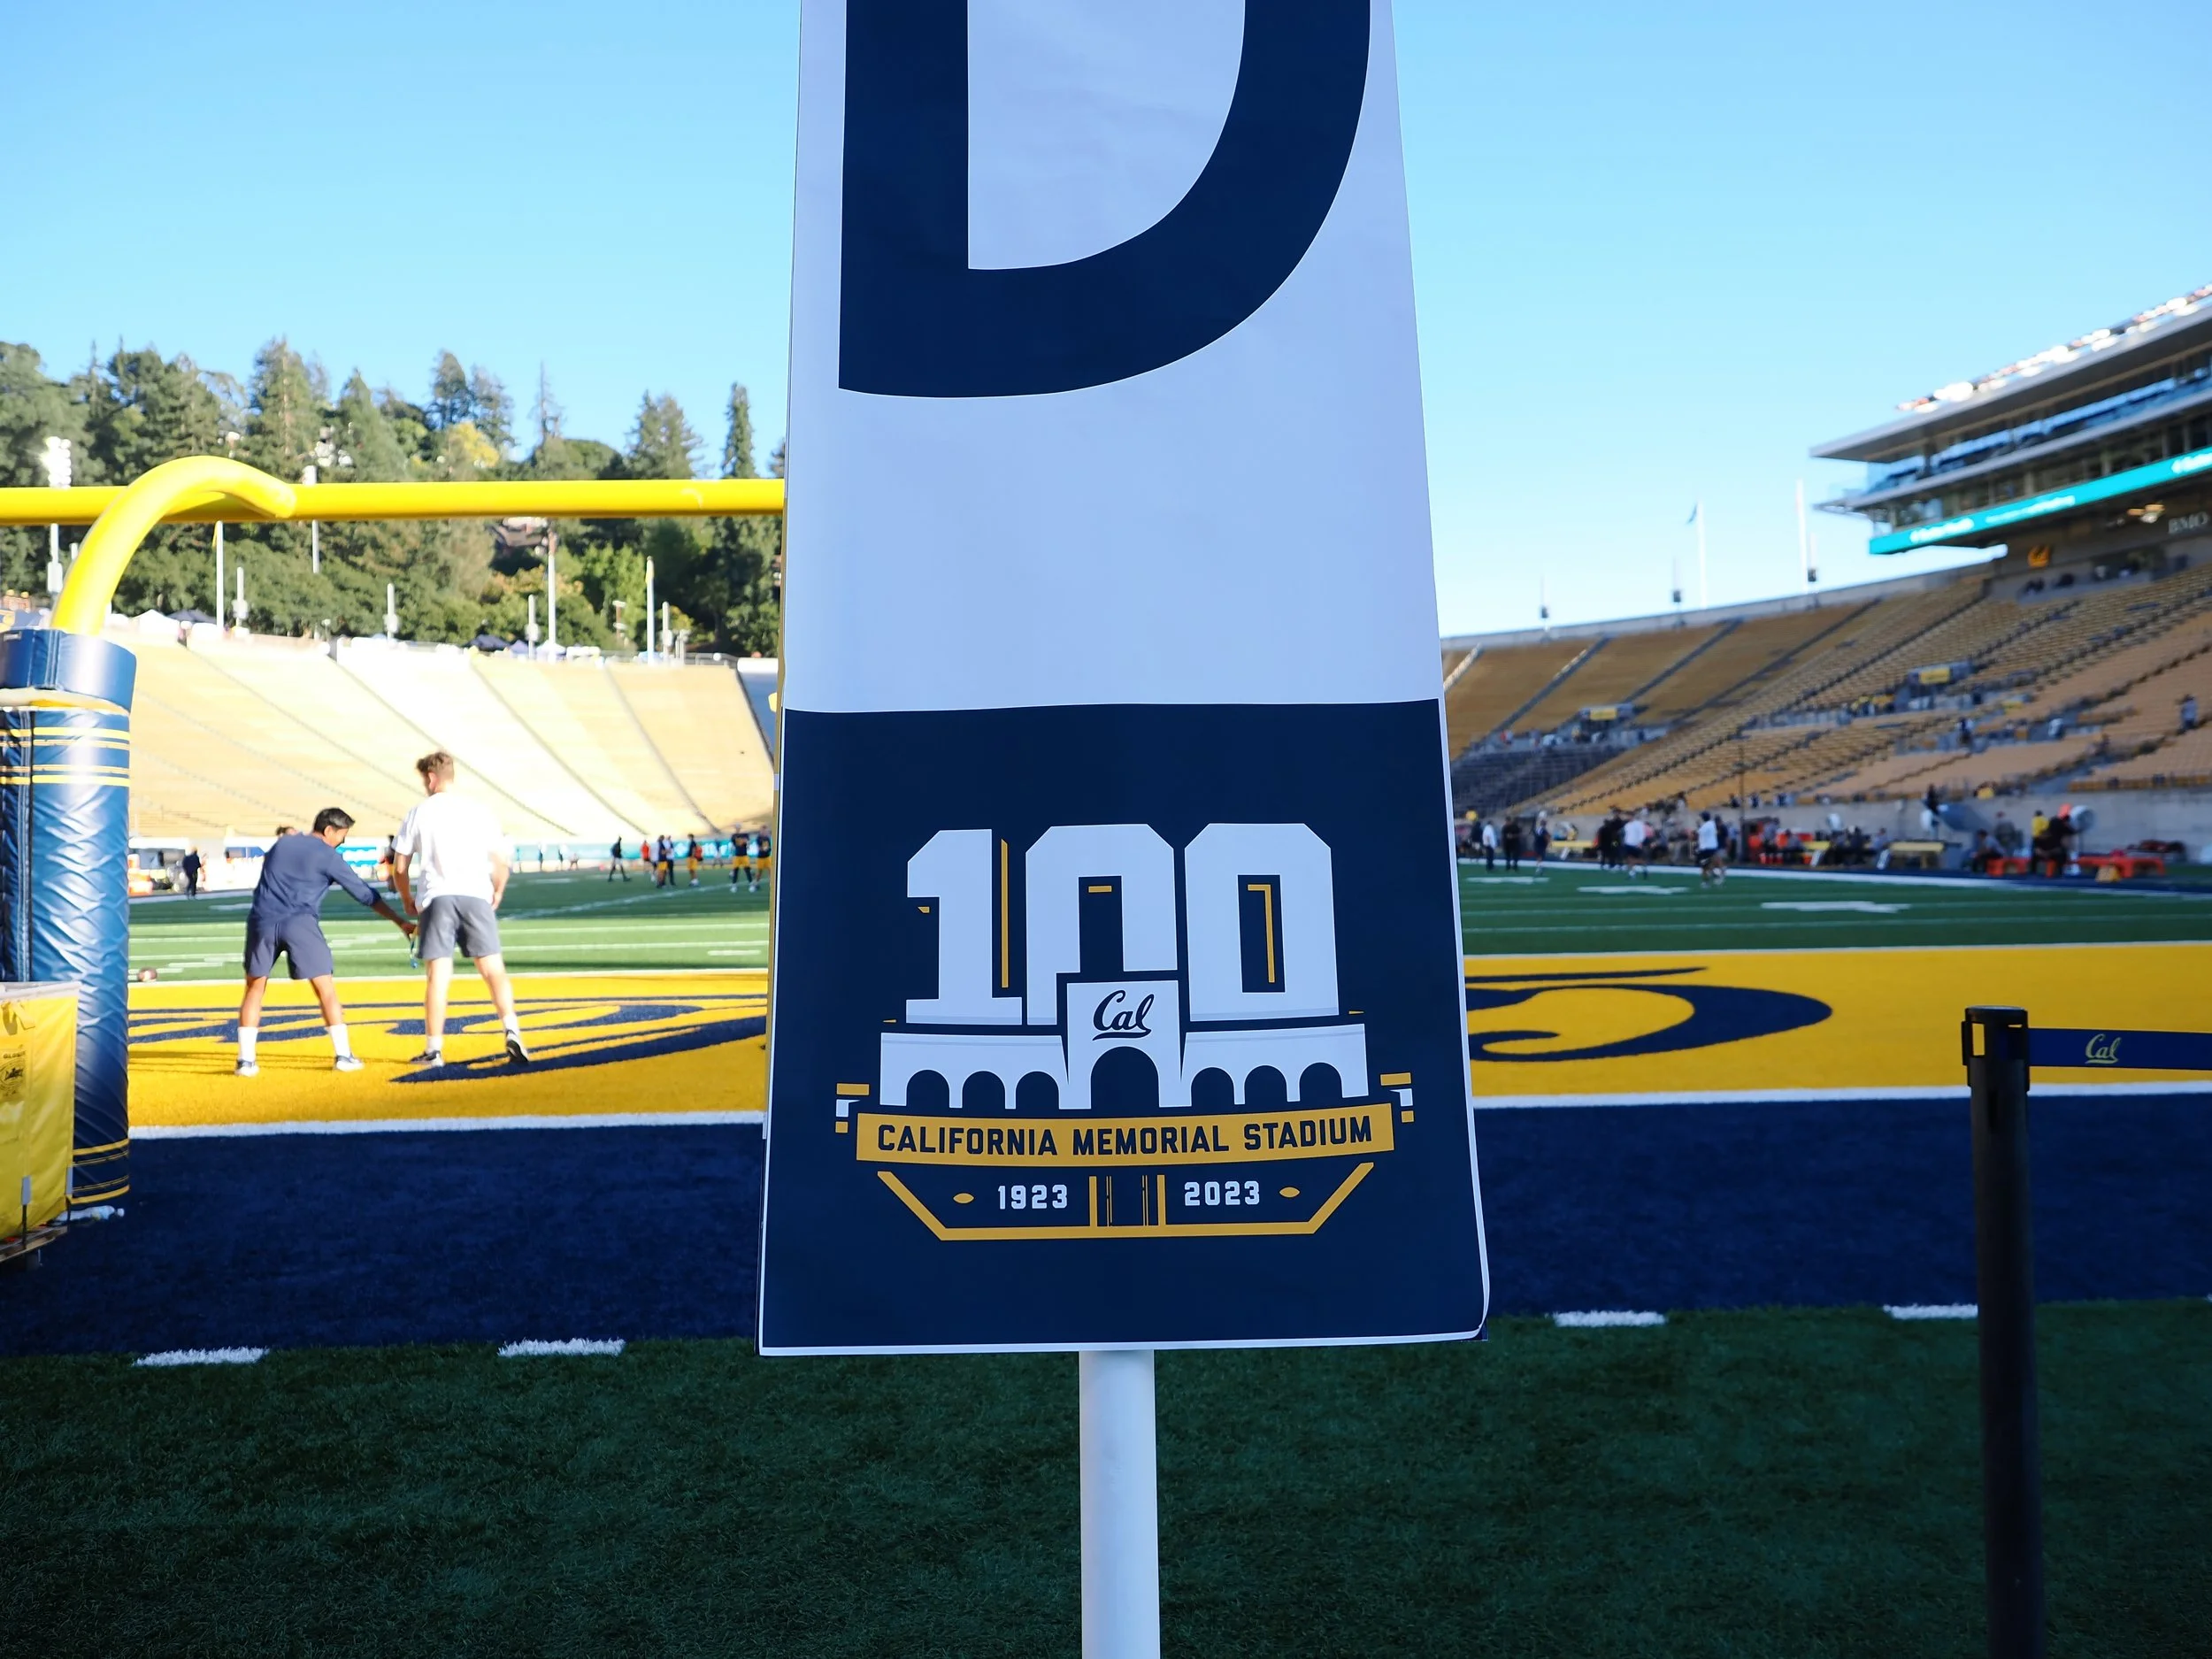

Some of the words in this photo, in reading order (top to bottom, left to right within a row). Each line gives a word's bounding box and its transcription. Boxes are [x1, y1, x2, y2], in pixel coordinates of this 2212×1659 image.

[905, 823, 1340, 1026] 100
[1092, 989, 1155, 1041] Cal
[2085, 1033, 2122, 1064] Cal
[878, 1124, 1058, 1156] CALIFORNIA
[1072, 1125, 1229, 1156] MEMORIAL
[1243, 1115, 1372, 1151] STADIUM
[997, 1184, 1068, 1210] 1923
[1184, 1180, 1260, 1207] 2023
